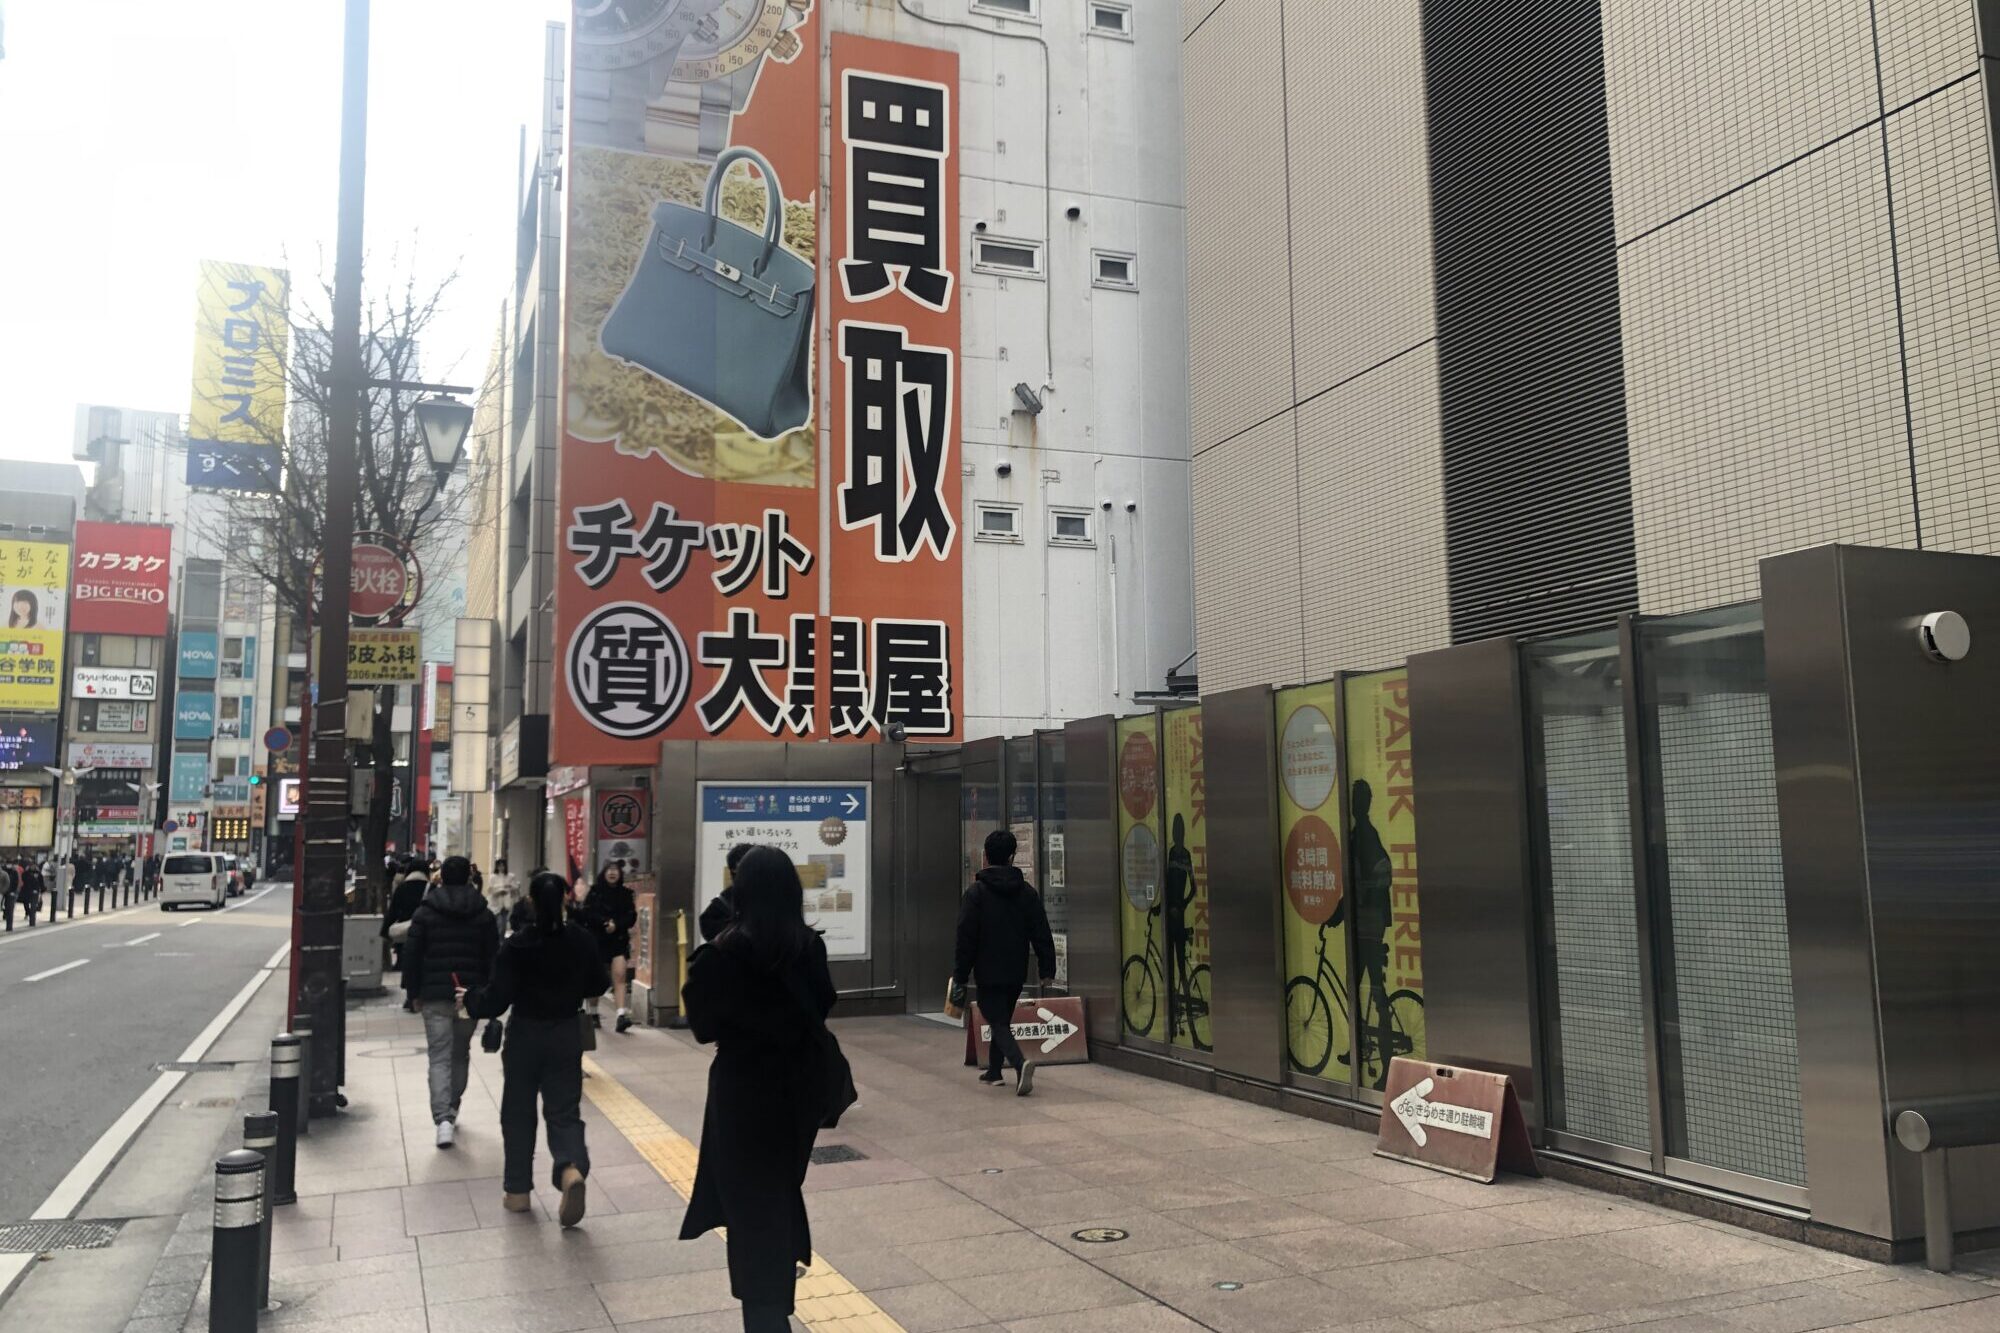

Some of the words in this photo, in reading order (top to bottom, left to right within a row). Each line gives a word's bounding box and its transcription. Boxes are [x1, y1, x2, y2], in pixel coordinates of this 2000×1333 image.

[766, 6, 782, 16] 200
[757, 28, 772, 38] 180
[744, 43, 759, 54] 160
[729, 53, 744, 66] 150
[838, 68, 956, 562] 買取
[567, 499, 814, 597] チケット
[78, 552, 166, 573] カラオケ
[75, 584, 111, 599] BIG
[115, 587, 165, 603] ECHO
[182, 650, 215, 660] NOVA
[580, 616, 676, 724] 質
[695, 607, 951, 737] 大黒屋
[100, 687, 118, 695] 入口
[179, 711, 211, 721] NOVA
[1383, 678, 1414, 823] PARK
[725, 826, 793, 840] 使い道いろいろ
[1296, 847, 1328, 868] 3時間
[1010, 1023, 1070, 1037] らめき通り駐輪場
[1415, 1103, 1486, 1131] きらめき通り駐輪場
